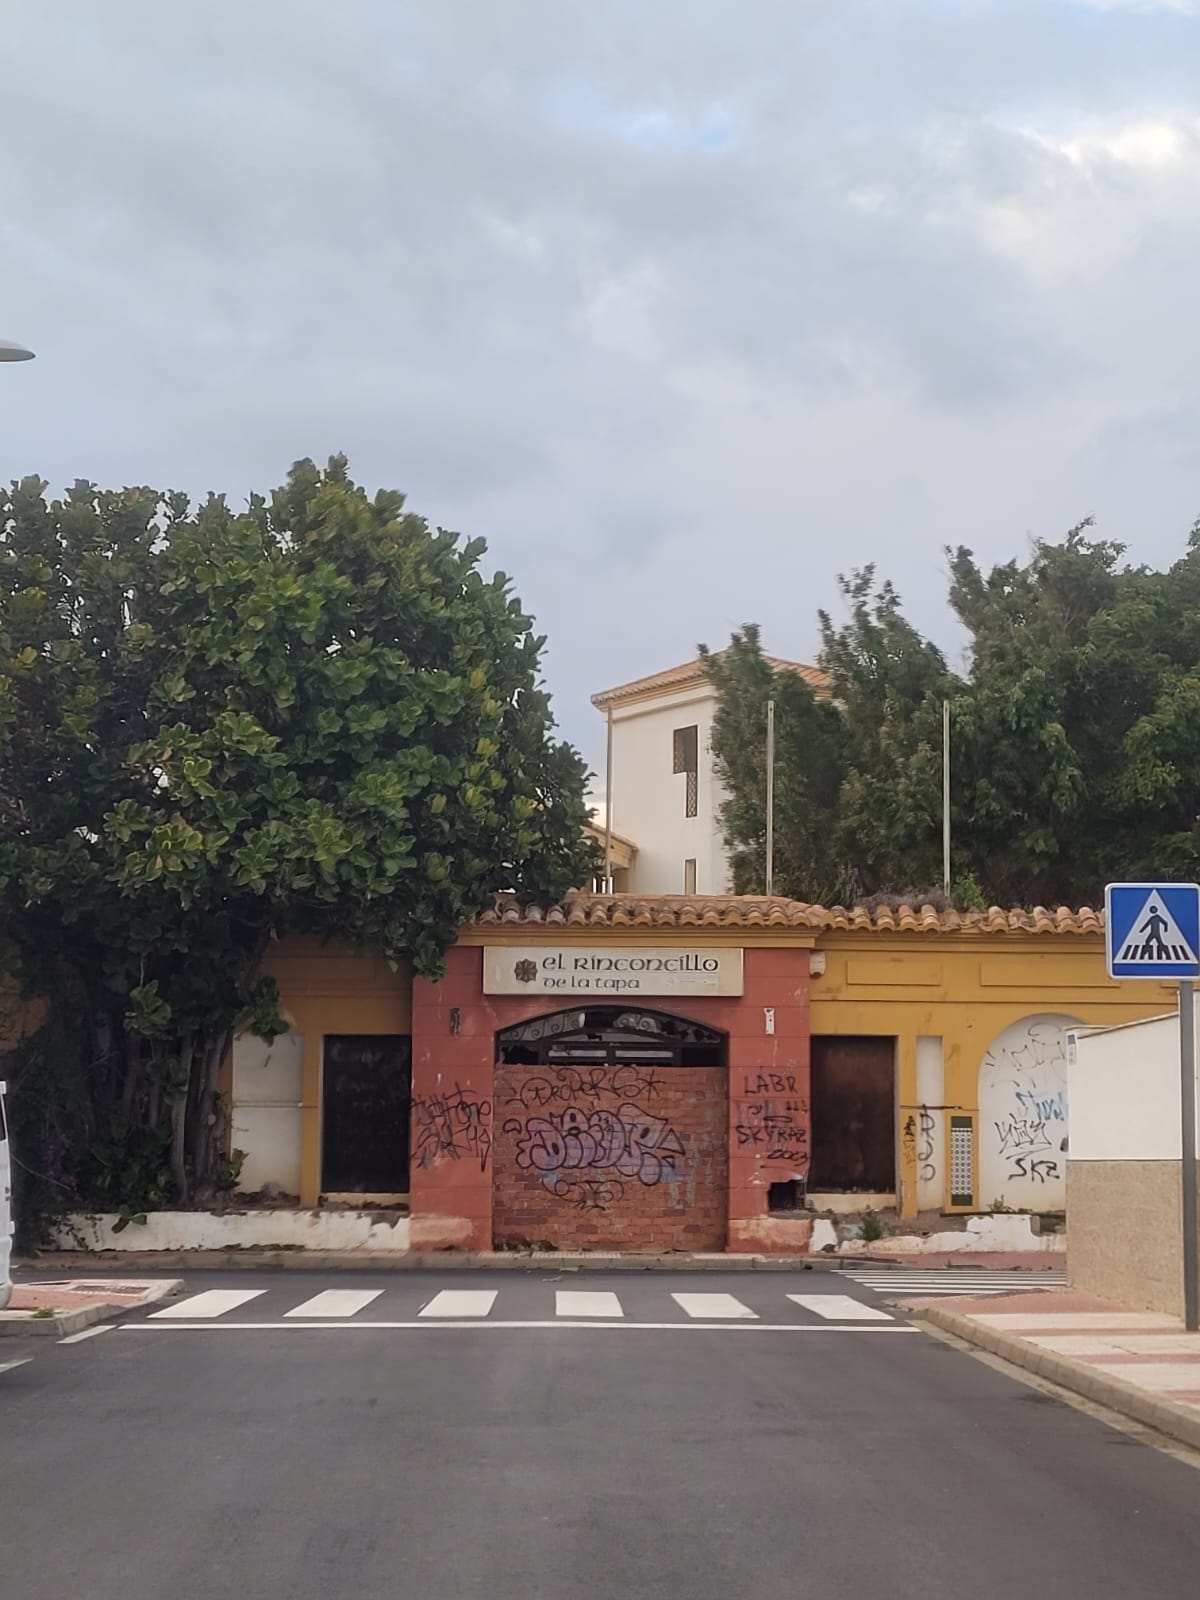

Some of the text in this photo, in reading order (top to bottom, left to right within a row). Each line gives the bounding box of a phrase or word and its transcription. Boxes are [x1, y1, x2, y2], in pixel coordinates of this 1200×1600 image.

[542, 953, 564, 971] el
[543, 976, 641, 992] de la tapa
